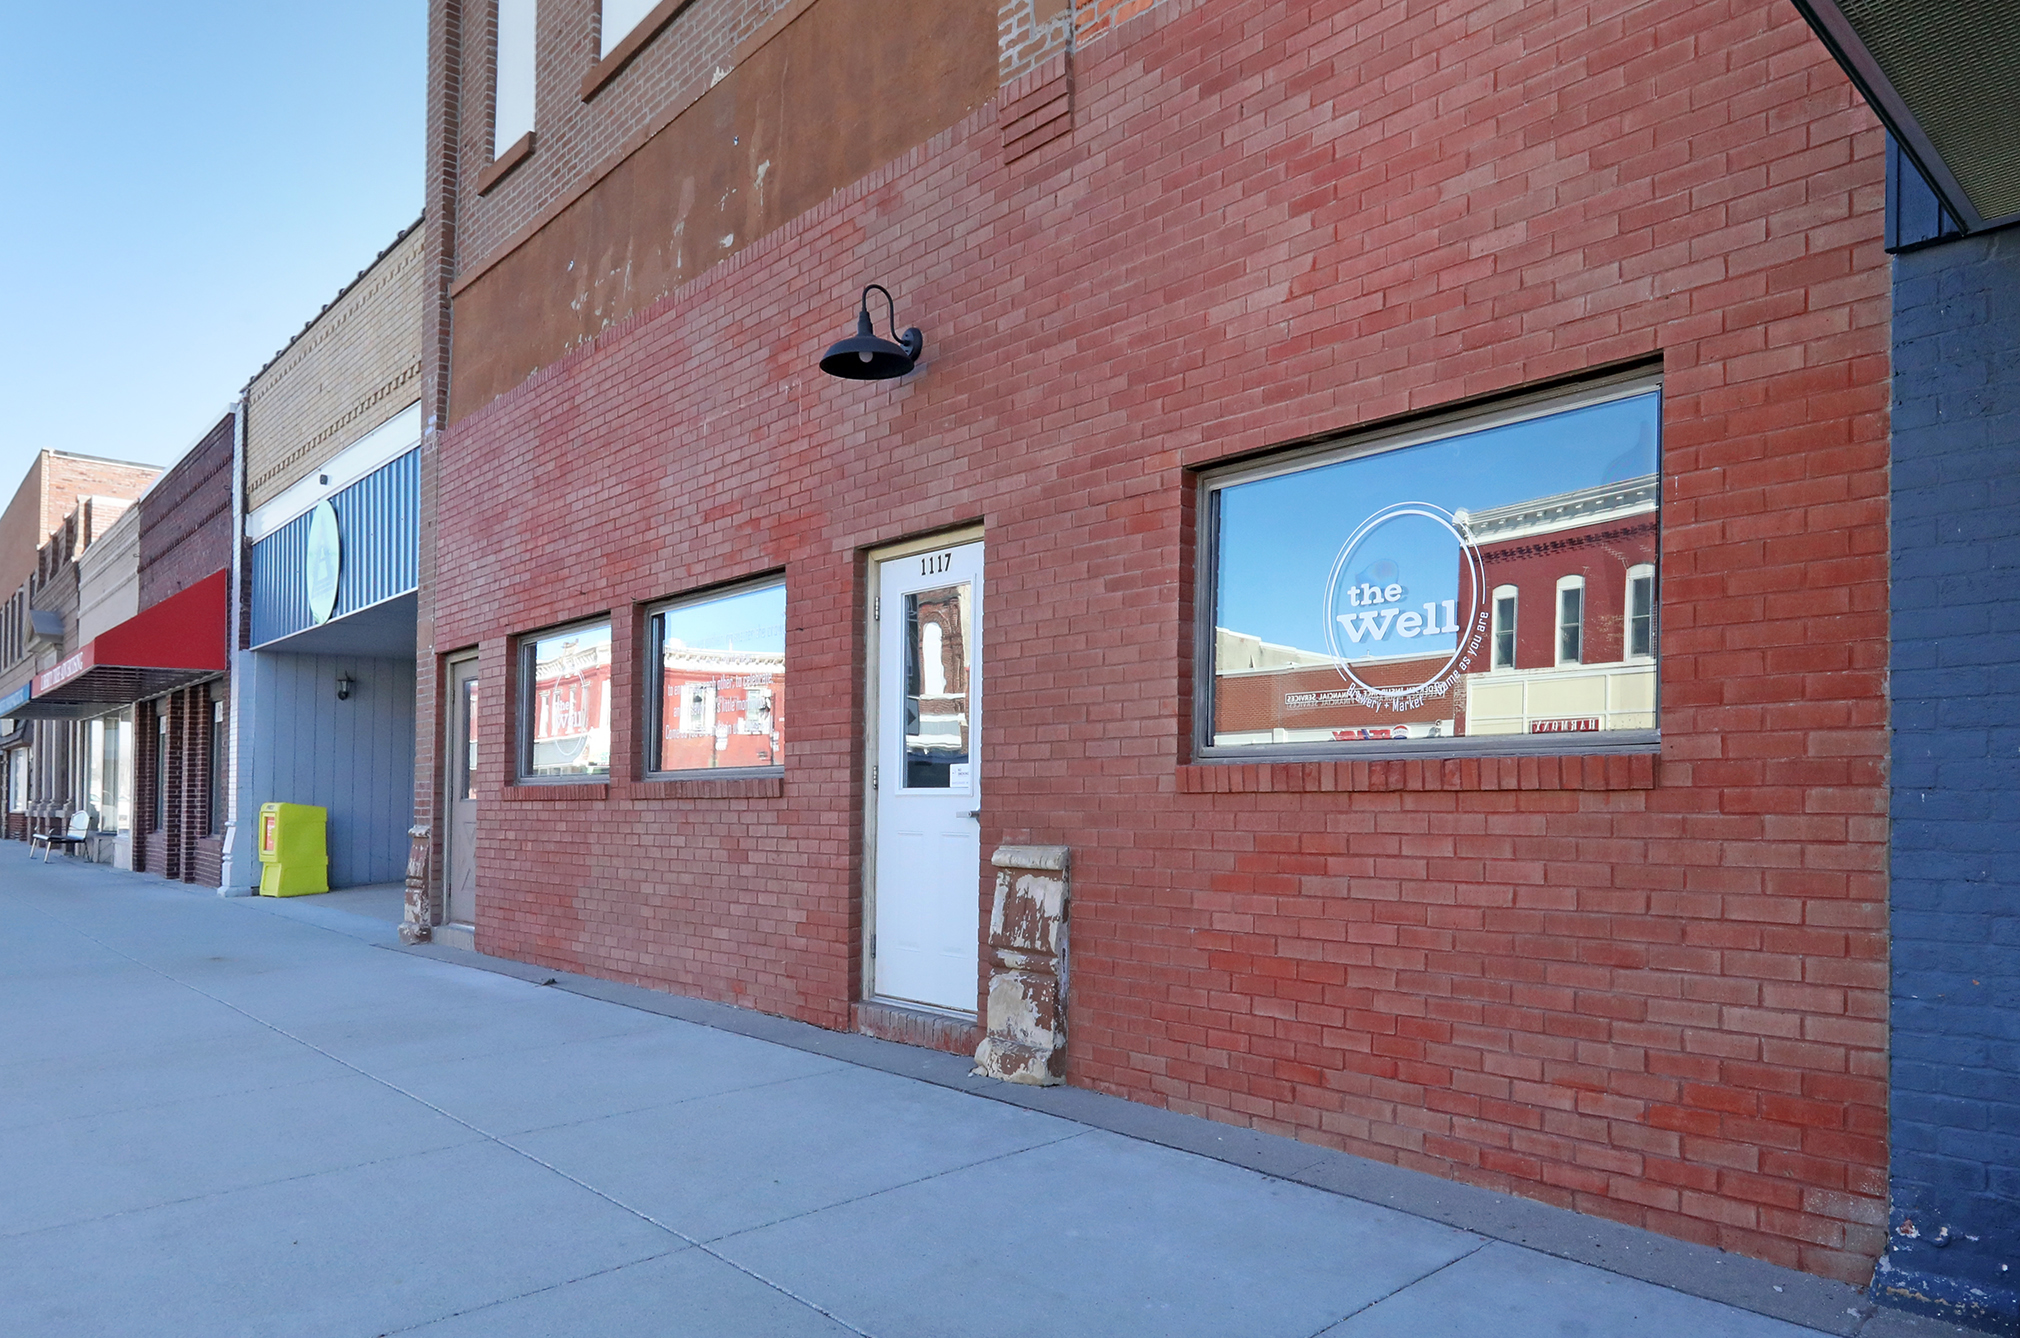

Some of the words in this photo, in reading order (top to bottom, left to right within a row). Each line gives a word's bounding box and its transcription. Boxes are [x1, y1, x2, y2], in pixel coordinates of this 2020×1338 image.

[921, 553, 952, 575] 1117
[1347, 583, 1403, 607] the
[1336, 599, 1460, 643] Well
[1459, 655, 1472, 671] as
[1467, 634, 1482, 657] you
[1476, 611, 1489, 632] are
[1392, 695, 1424, 712] Market
